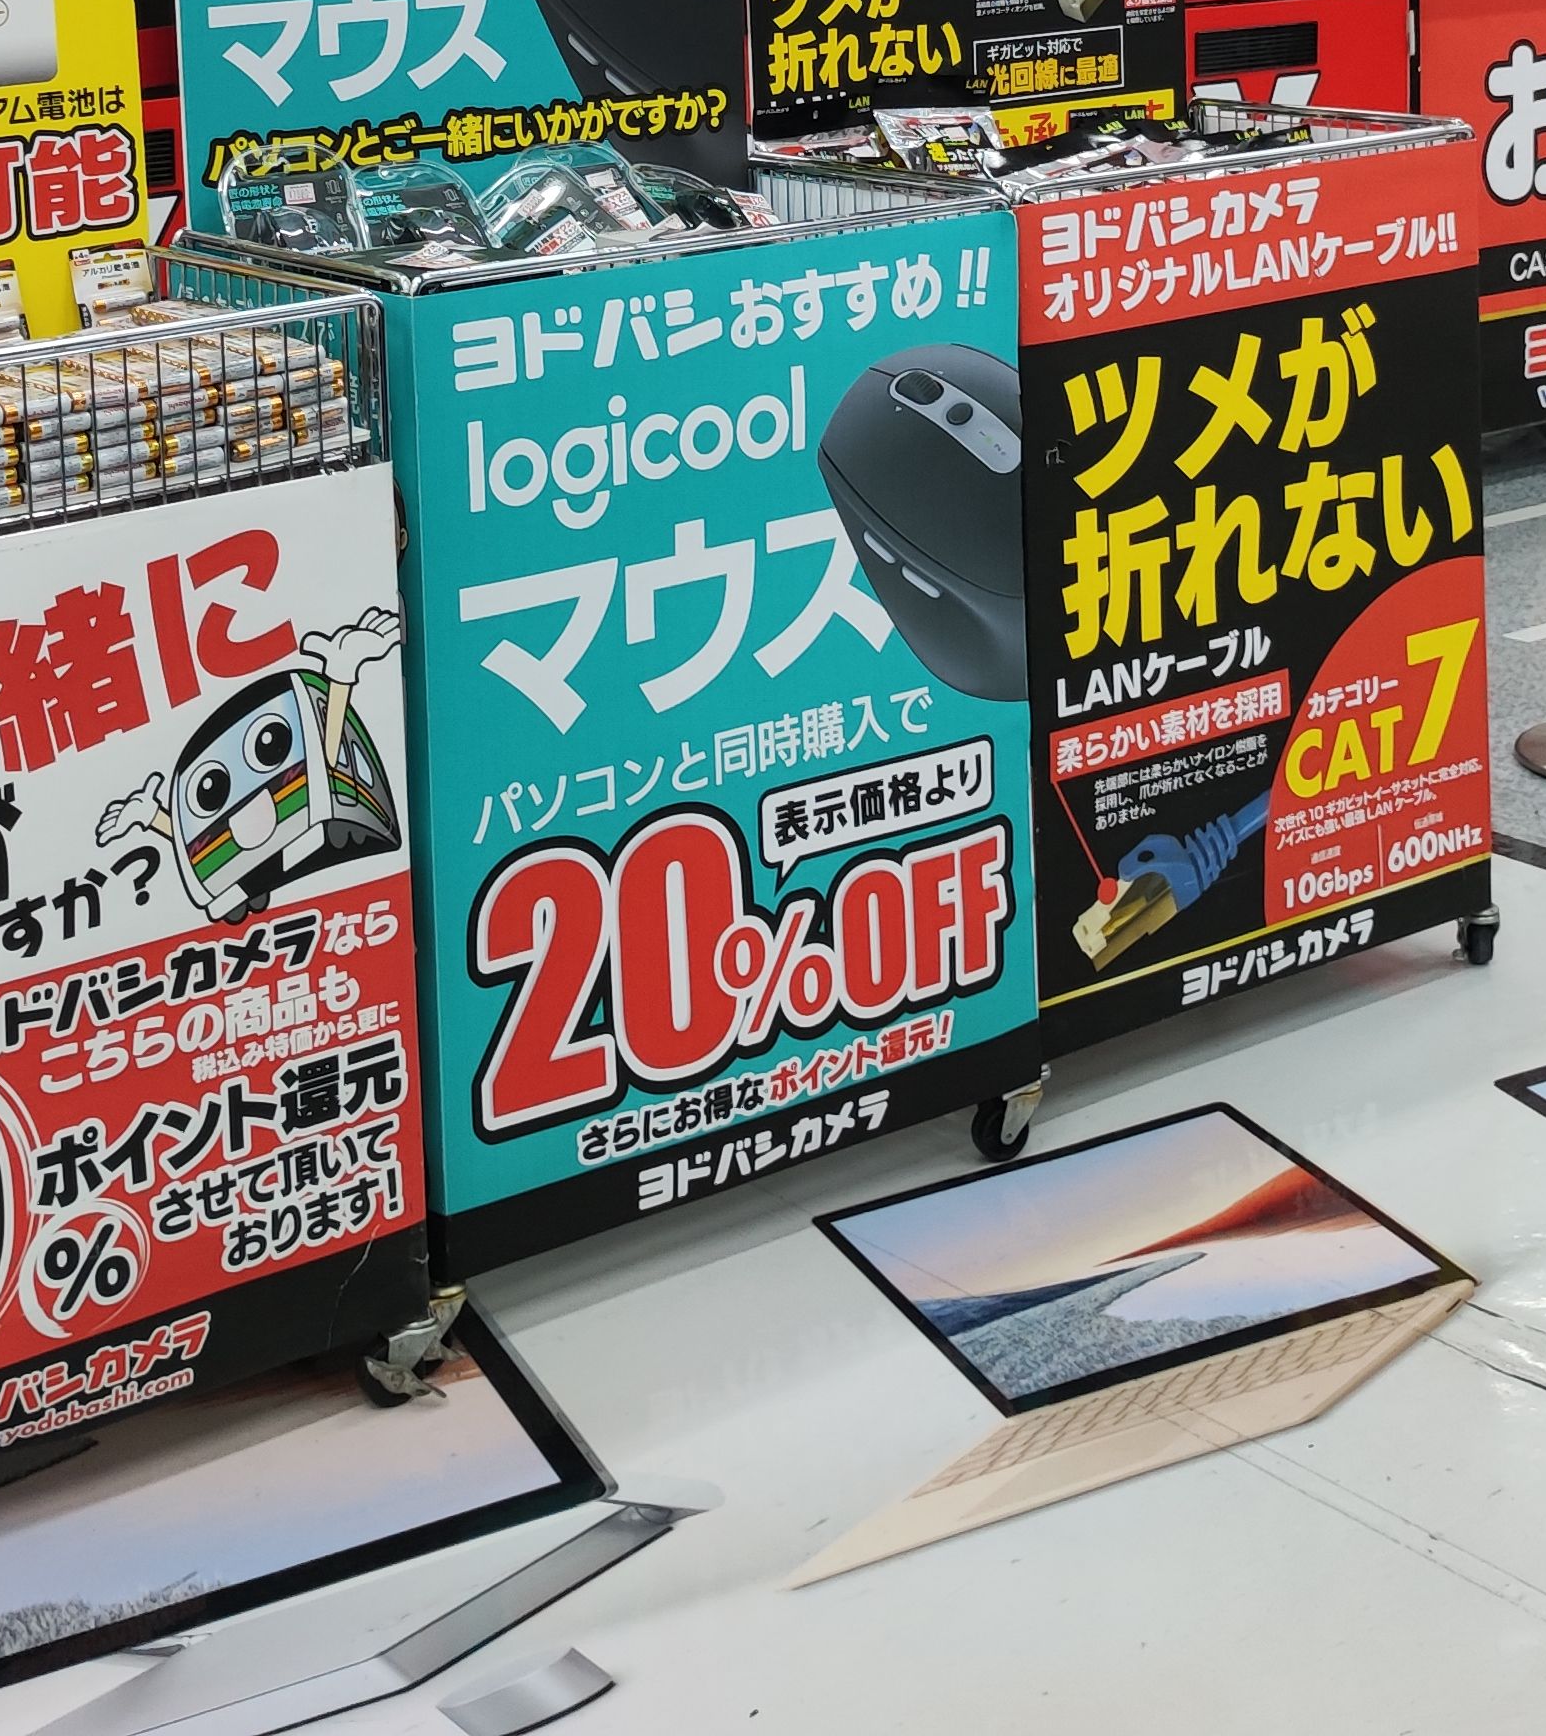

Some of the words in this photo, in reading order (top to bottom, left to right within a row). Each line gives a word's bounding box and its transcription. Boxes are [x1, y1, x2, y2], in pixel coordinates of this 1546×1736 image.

[767, 20, 964, 96] 折れない
[848, 94, 871, 109] LAN
[986, 37, 1084, 61] ギガビット対応で
[986, 53, 1120, 96] 光回線に最適
[209, 88, 729, 182] パソコンとご一緒にいかがですか?
[1041, 176, 1321, 267] ヨドバシカメラ
[1043, 211, 1459, 324] オリジナルLANケーブル!!
[453, 246, 990, 392] ヨドバシおすすめ!!
[467, 365, 807, 529] logicool
[1062, 302, 1378, 500] ツメが
[1062, 443, 1474, 660] 折れない
[458, 507, 895, 736] マウス
[1056, 625, 1272, 719] LANケーブル
[1055, 681, 1284, 775] 柔らかい素材を採用
[1307, 676, 1399, 721] カテゴリー
[473, 685, 935, 846] パソコンと同時購入で
[773, 753, 987, 849] 表示価格より
[1095, 806, 1157, 832] ありません。
[1283, 864, 1375, 909] 10Gbps
[475, 813, 1009, 1132] 20%OFF
[1181, 908, 1375, 1005] ヨドバシカメラ
[39, 965, 360, 1094] こちらの商品も
[33, 1034, 407, 1208] ポイント還元
[577, 1011, 955, 1165] さらにお得なポイント還元!
[153, 1115, 399, 1238] させて頂いて
[638, 1089, 891, 1211] ヨドバシカメラ
